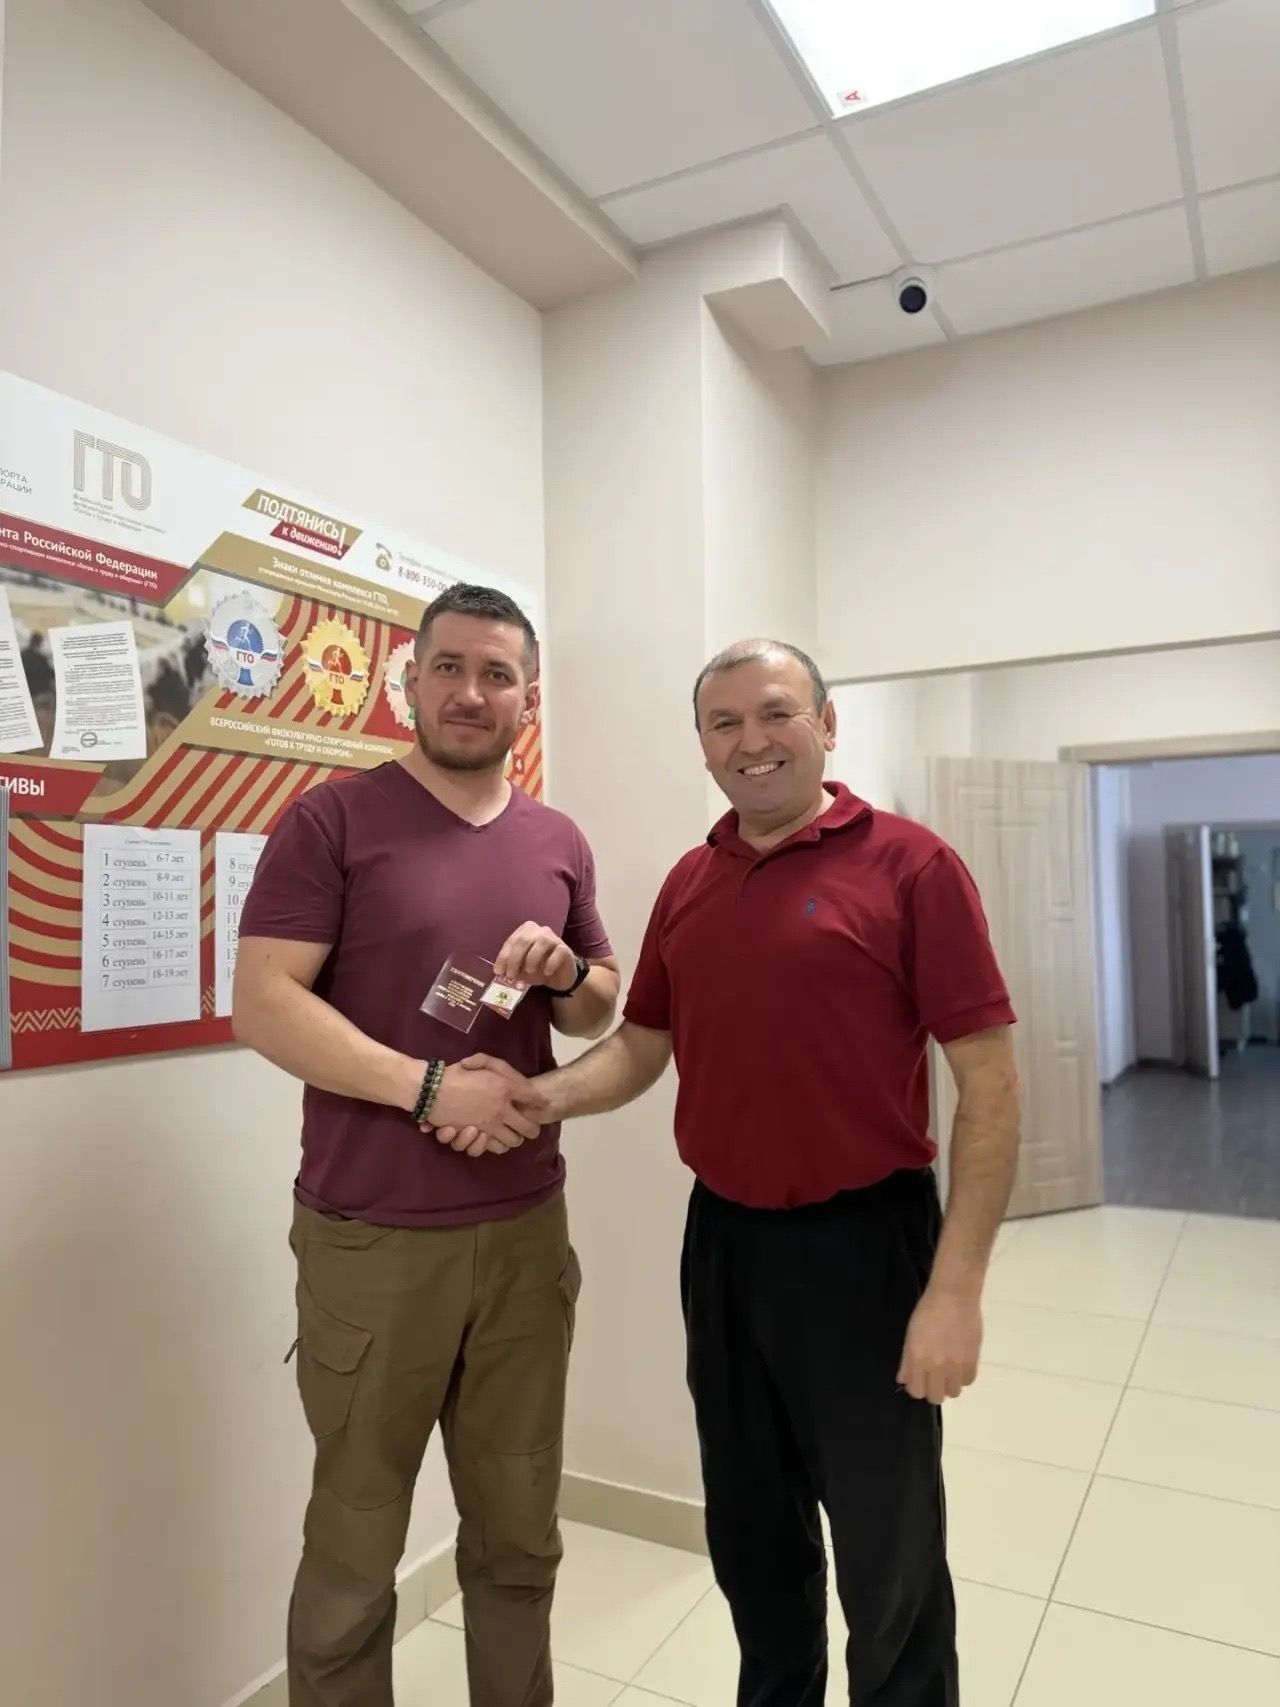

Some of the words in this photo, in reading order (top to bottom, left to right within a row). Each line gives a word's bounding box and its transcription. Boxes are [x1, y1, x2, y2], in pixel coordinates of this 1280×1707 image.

[0, 467, 27, 483] ОРТА
[73, 430, 152, 511] ГТО
[24, 530, 91, 561] Российской
[95, 552, 158, 580] Федерации
[273, 556, 298, 574] Знаки
[300, 568, 331, 586] отличия
[236, 651, 255, 664] ГТО
[329, 673, 345, 685] ГТО
[210, 716, 271, 734] ВСЕРОССИЙСКИЙ
[104, 853, 109, 866] 1
[113, 859, 147, 869] ступень
[156, 853, 170, 862] 6-7
[229, 858, 236, 870] 8
[103, 873, 110, 887] 2
[113, 879, 147, 889] ступень
[156, 873, 170, 882] 8-9
[229, 875, 236, 888] 9
[103, 893, 110, 907] 3
[112, 899, 146, 909] ступень
[227, 894, 240, 906] 10
[102, 914, 109, 928] 4
[112, 919, 147, 929] ступень
[226, 912, 237, 924] 11
[102, 934, 109, 947] 5
[112, 939, 147, 949] ступень
[102, 954, 109, 968] 6
[112, 959, 146, 969] ступень
[102, 974, 109, 988] 7
[112, 979, 146, 989] ступень
